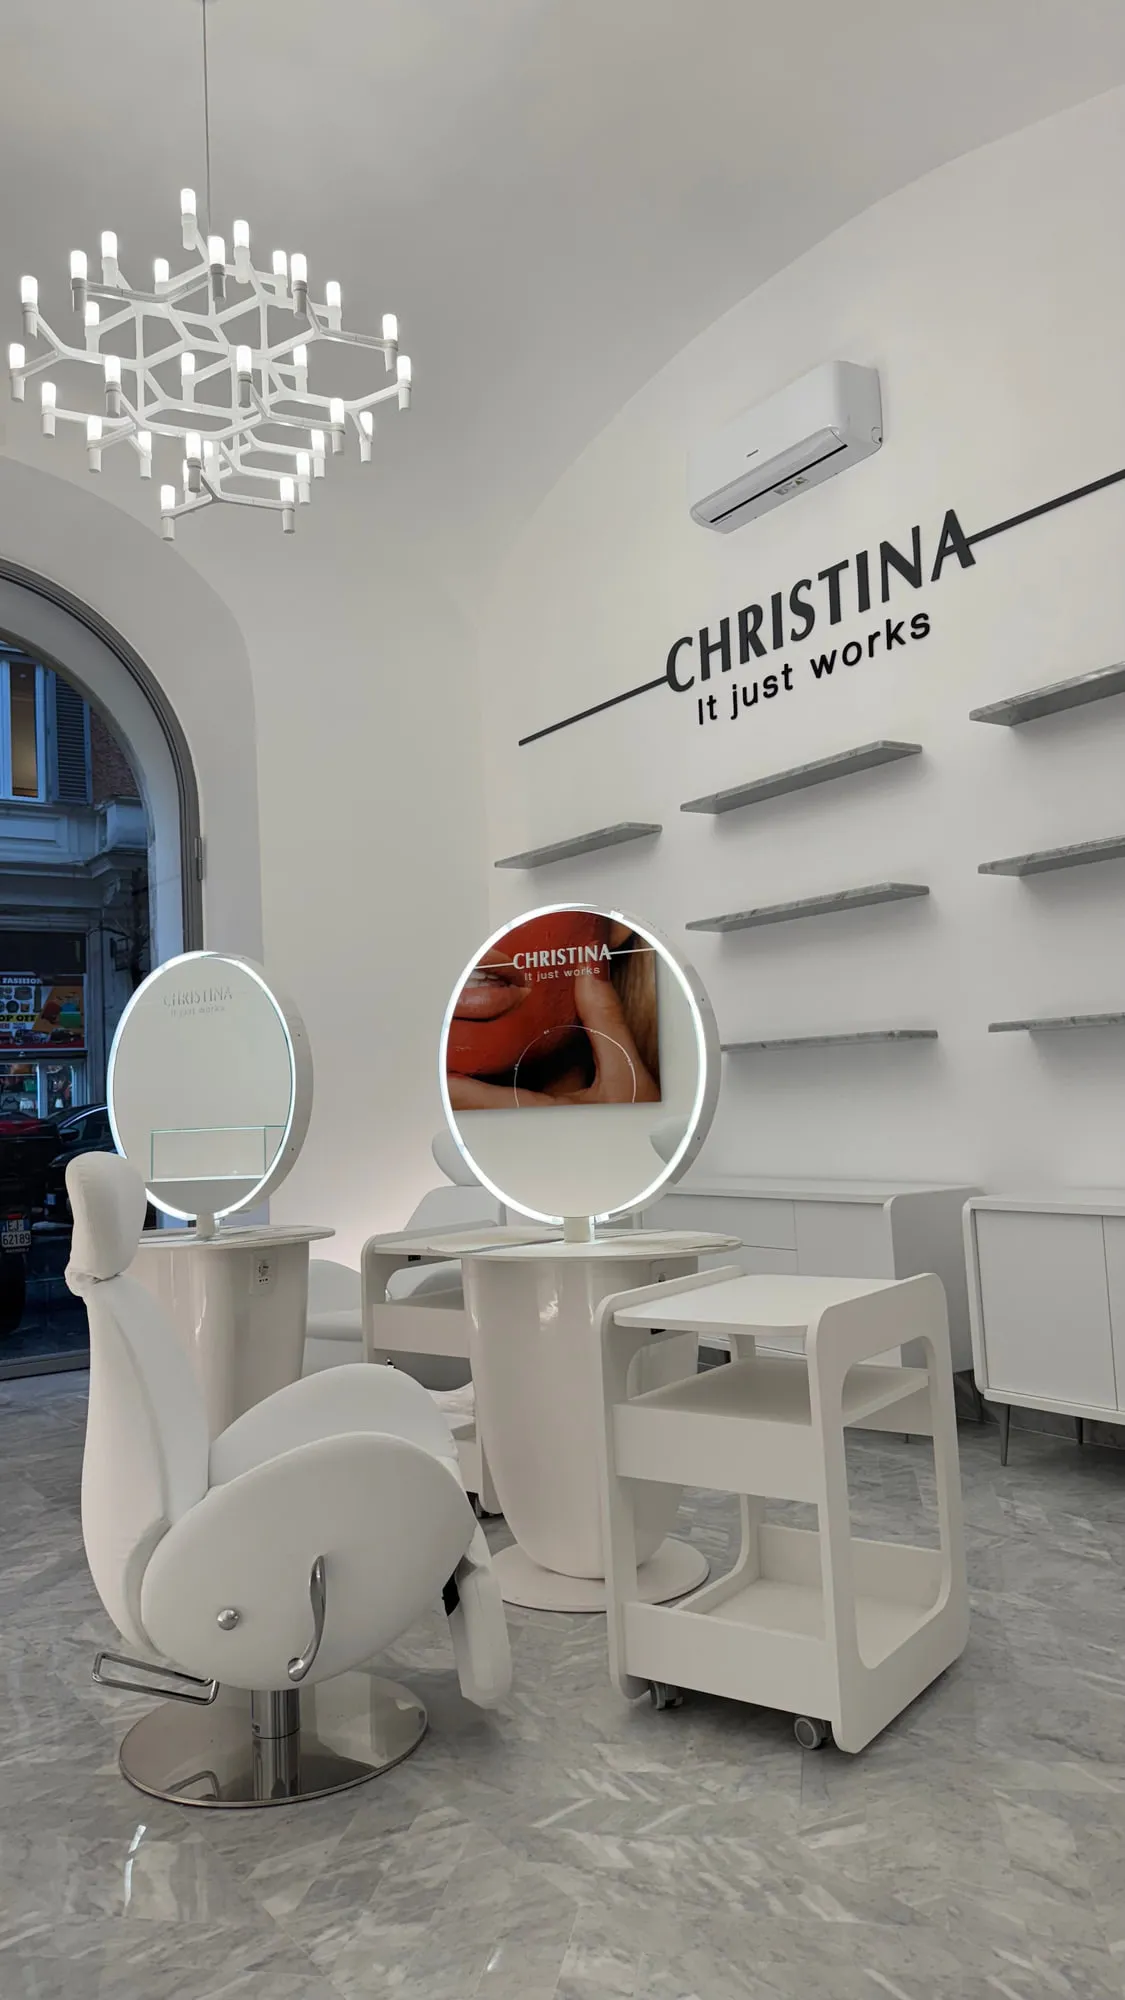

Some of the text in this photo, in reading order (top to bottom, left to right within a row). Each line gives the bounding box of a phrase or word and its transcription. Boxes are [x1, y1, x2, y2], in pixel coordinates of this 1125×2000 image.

[666, 509, 976, 693] CHRISTINA
[698, 613, 930, 725] It just works
[513, 943, 612, 970] CHRISTINA
[524, 966, 601, 982] It just works
[163, 986, 233, 1007] CHRISTINA
[2, 1233, 31, 1245] 62189
